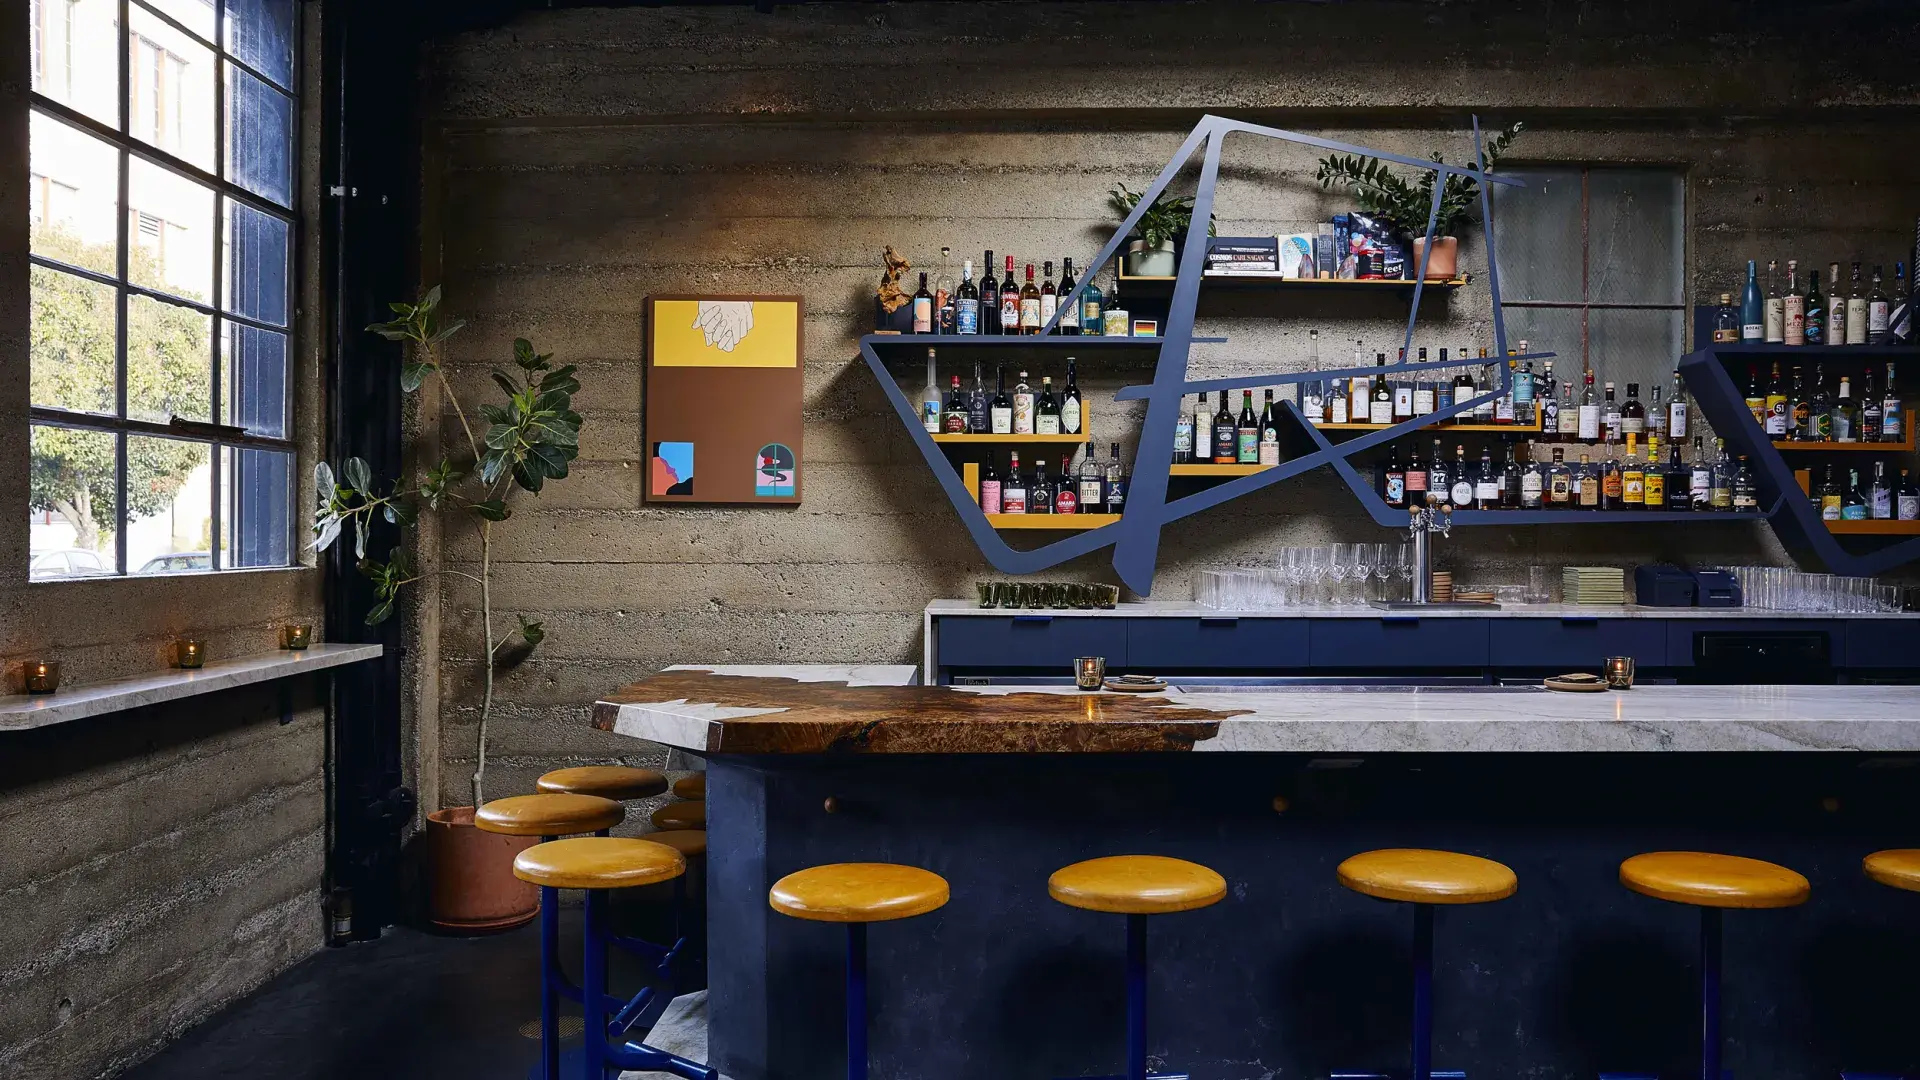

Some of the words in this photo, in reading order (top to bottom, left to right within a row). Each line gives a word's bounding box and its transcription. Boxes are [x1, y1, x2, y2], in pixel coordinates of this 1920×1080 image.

[1319, 240, 1332, 249] BAR
[1776, 404, 1785, 413] 51
[1433, 472, 1446, 483] 77
[1081, 489, 1099, 497] BITTER
